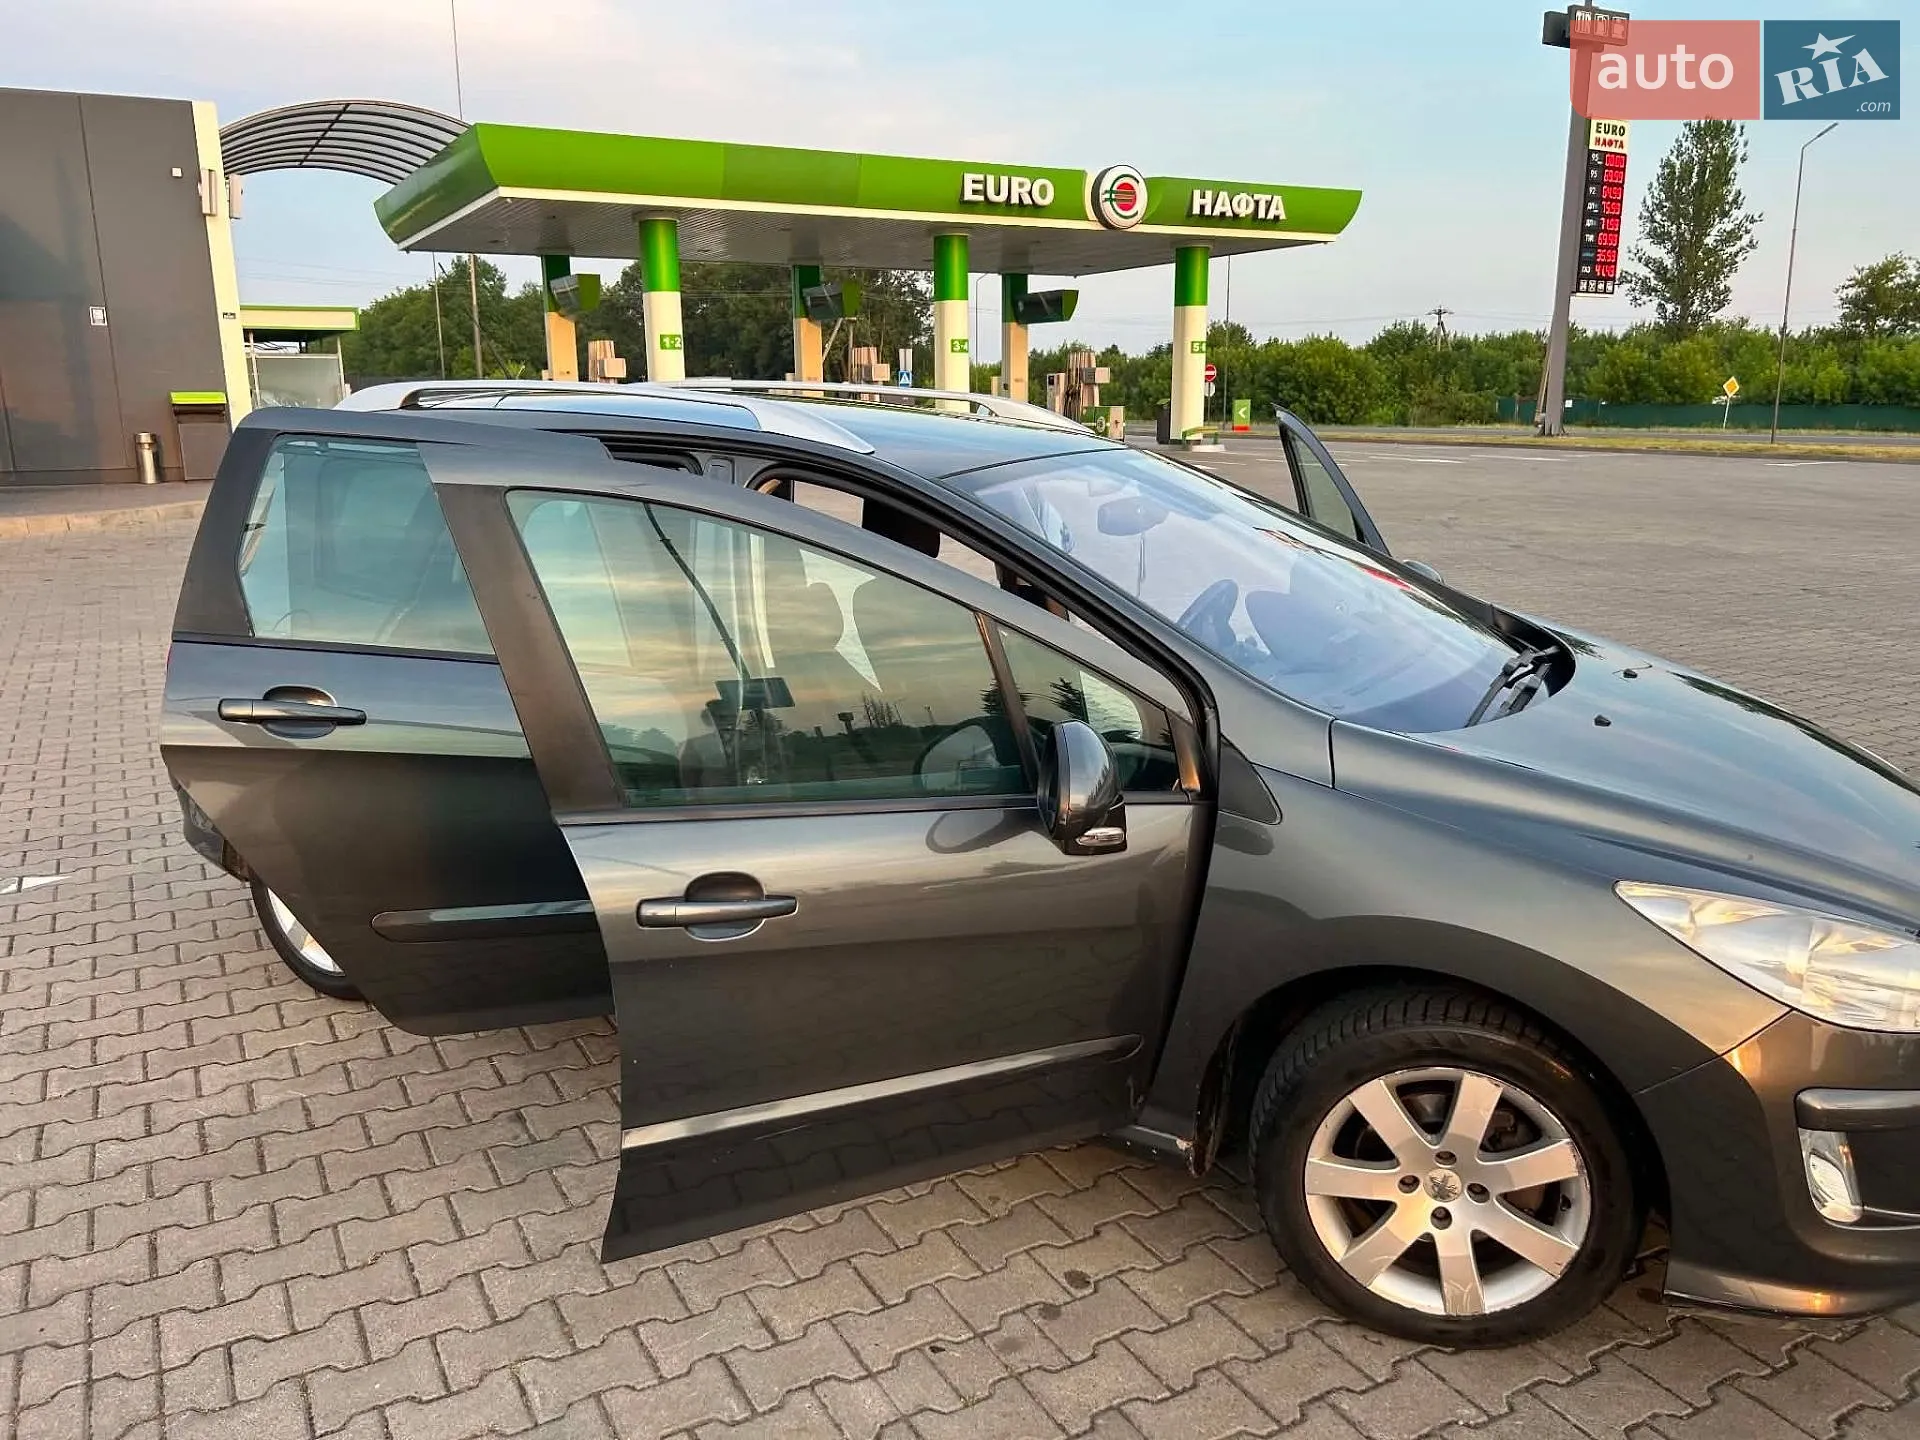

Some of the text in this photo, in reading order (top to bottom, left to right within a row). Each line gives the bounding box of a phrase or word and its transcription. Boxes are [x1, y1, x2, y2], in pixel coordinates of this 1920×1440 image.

[1595, 122, 1625, 137] EURO
[1594, 136, 1624, 150] НАФТА
[1590, 169, 1598, 179] 95
[963, 172, 1055, 207] EURO
[1588, 186, 1597, 195] 92
[1191, 189, 1288, 220] НАФТА
